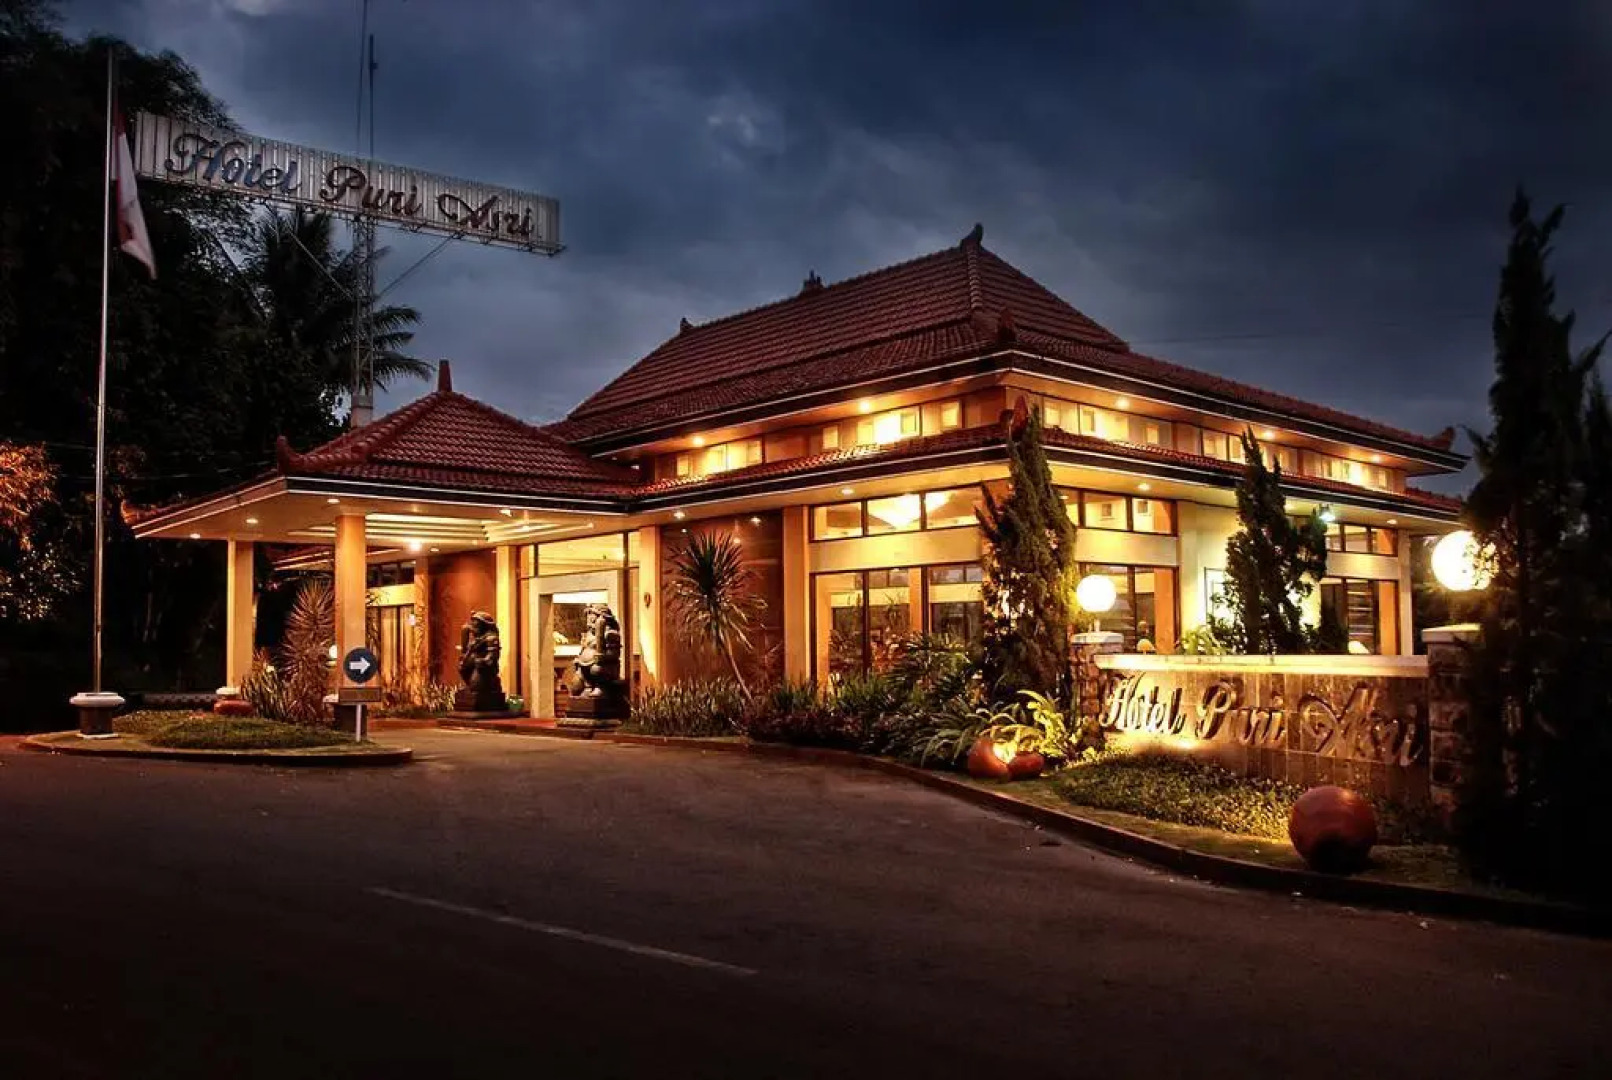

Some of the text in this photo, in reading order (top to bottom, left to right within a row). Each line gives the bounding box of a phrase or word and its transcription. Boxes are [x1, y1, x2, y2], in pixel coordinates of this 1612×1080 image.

[164, 132, 536, 236] Hotel Puri Asri
[1100, 669, 1186, 735] Hotel
[1195, 681, 1288, 746] Puri
